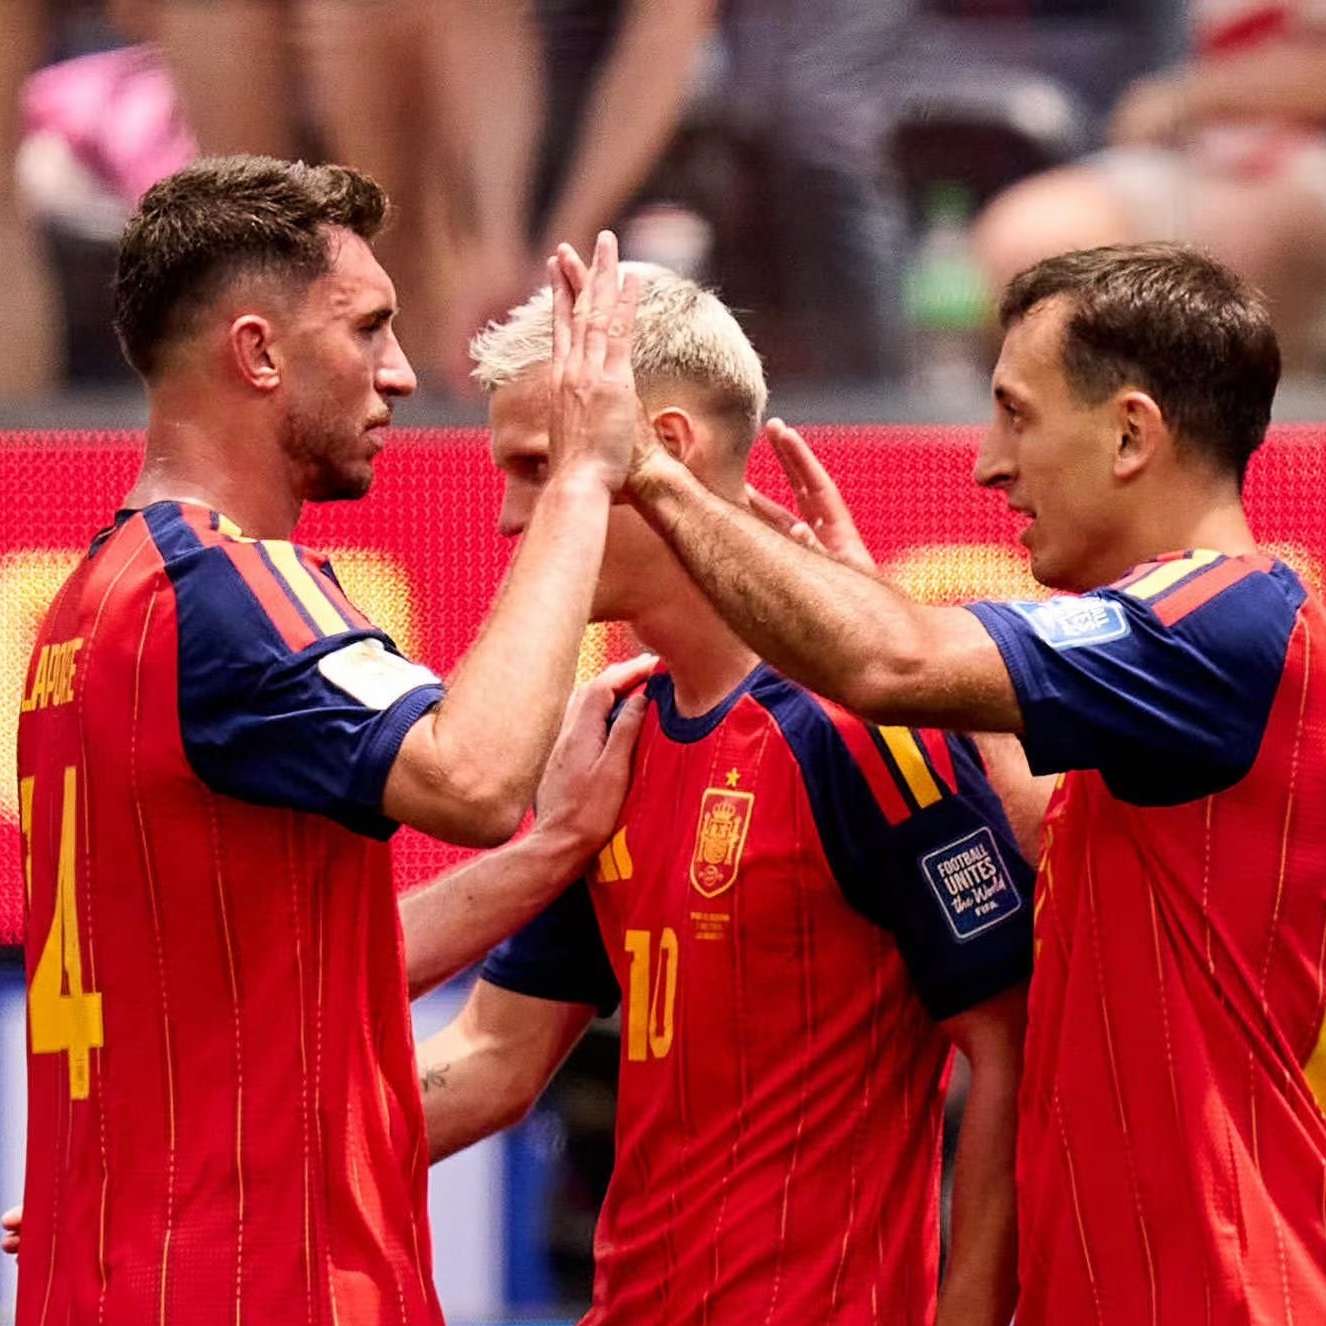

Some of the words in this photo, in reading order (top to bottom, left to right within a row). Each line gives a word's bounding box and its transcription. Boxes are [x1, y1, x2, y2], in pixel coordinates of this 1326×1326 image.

[937, 843, 988, 878] FOOTBALL
[943, 856, 997, 896] UNITES
[625, 927, 678, 1061] 10
